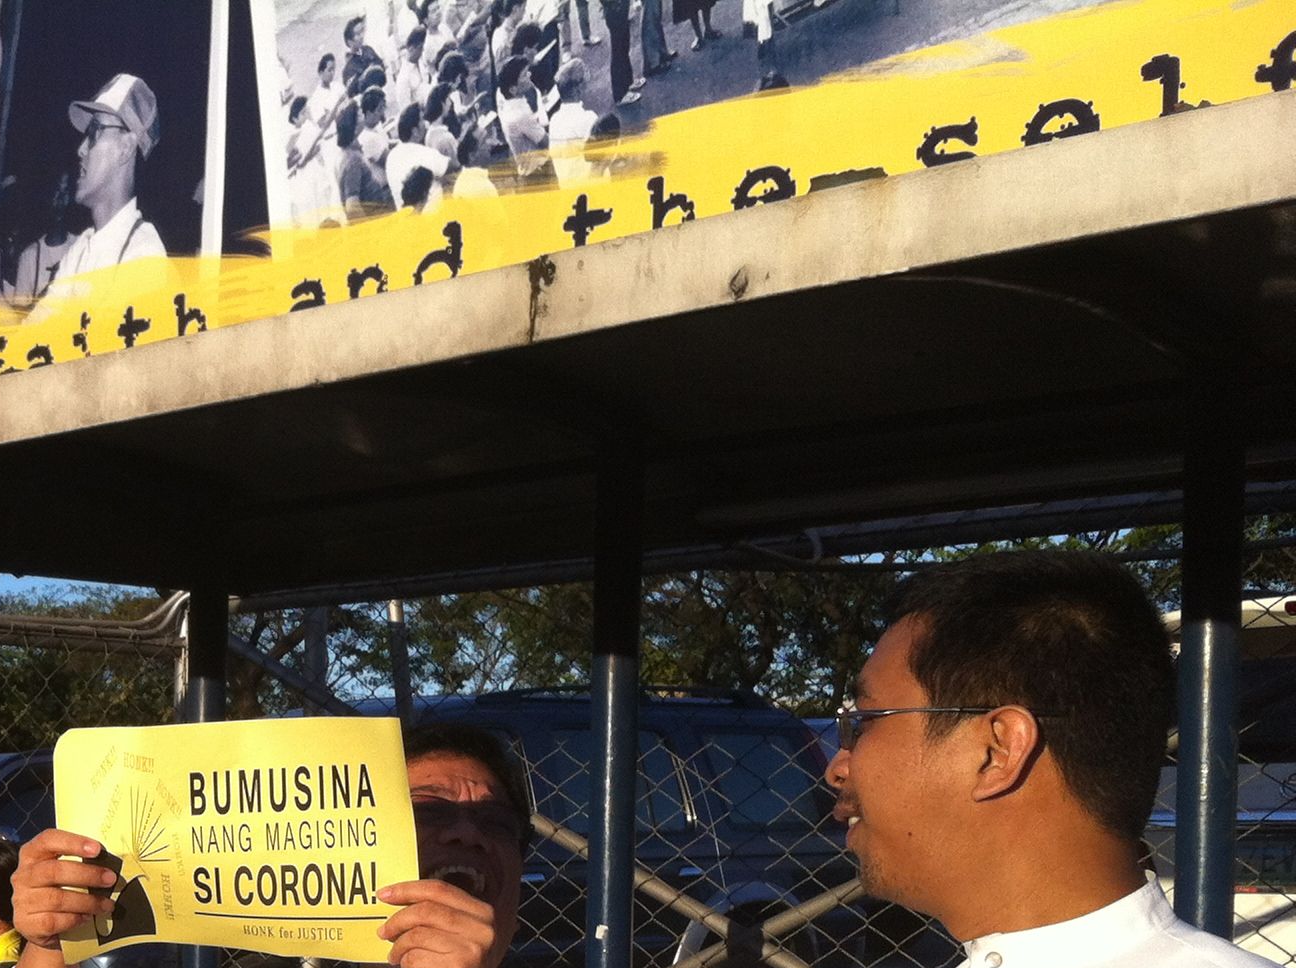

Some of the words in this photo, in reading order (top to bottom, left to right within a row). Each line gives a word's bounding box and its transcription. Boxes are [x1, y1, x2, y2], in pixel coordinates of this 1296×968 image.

[189, 763, 376, 816] BUMUSINA
[191, 823, 252, 854] NANG
[266, 817, 377, 851] MAGISING
[193, 866, 222, 905] SI
[234, 861, 377, 906] CORONA!
[243, 924, 274, 938] HONK
[279, 926, 293, 939] for
[297, 927, 344, 941] JUSTICE
